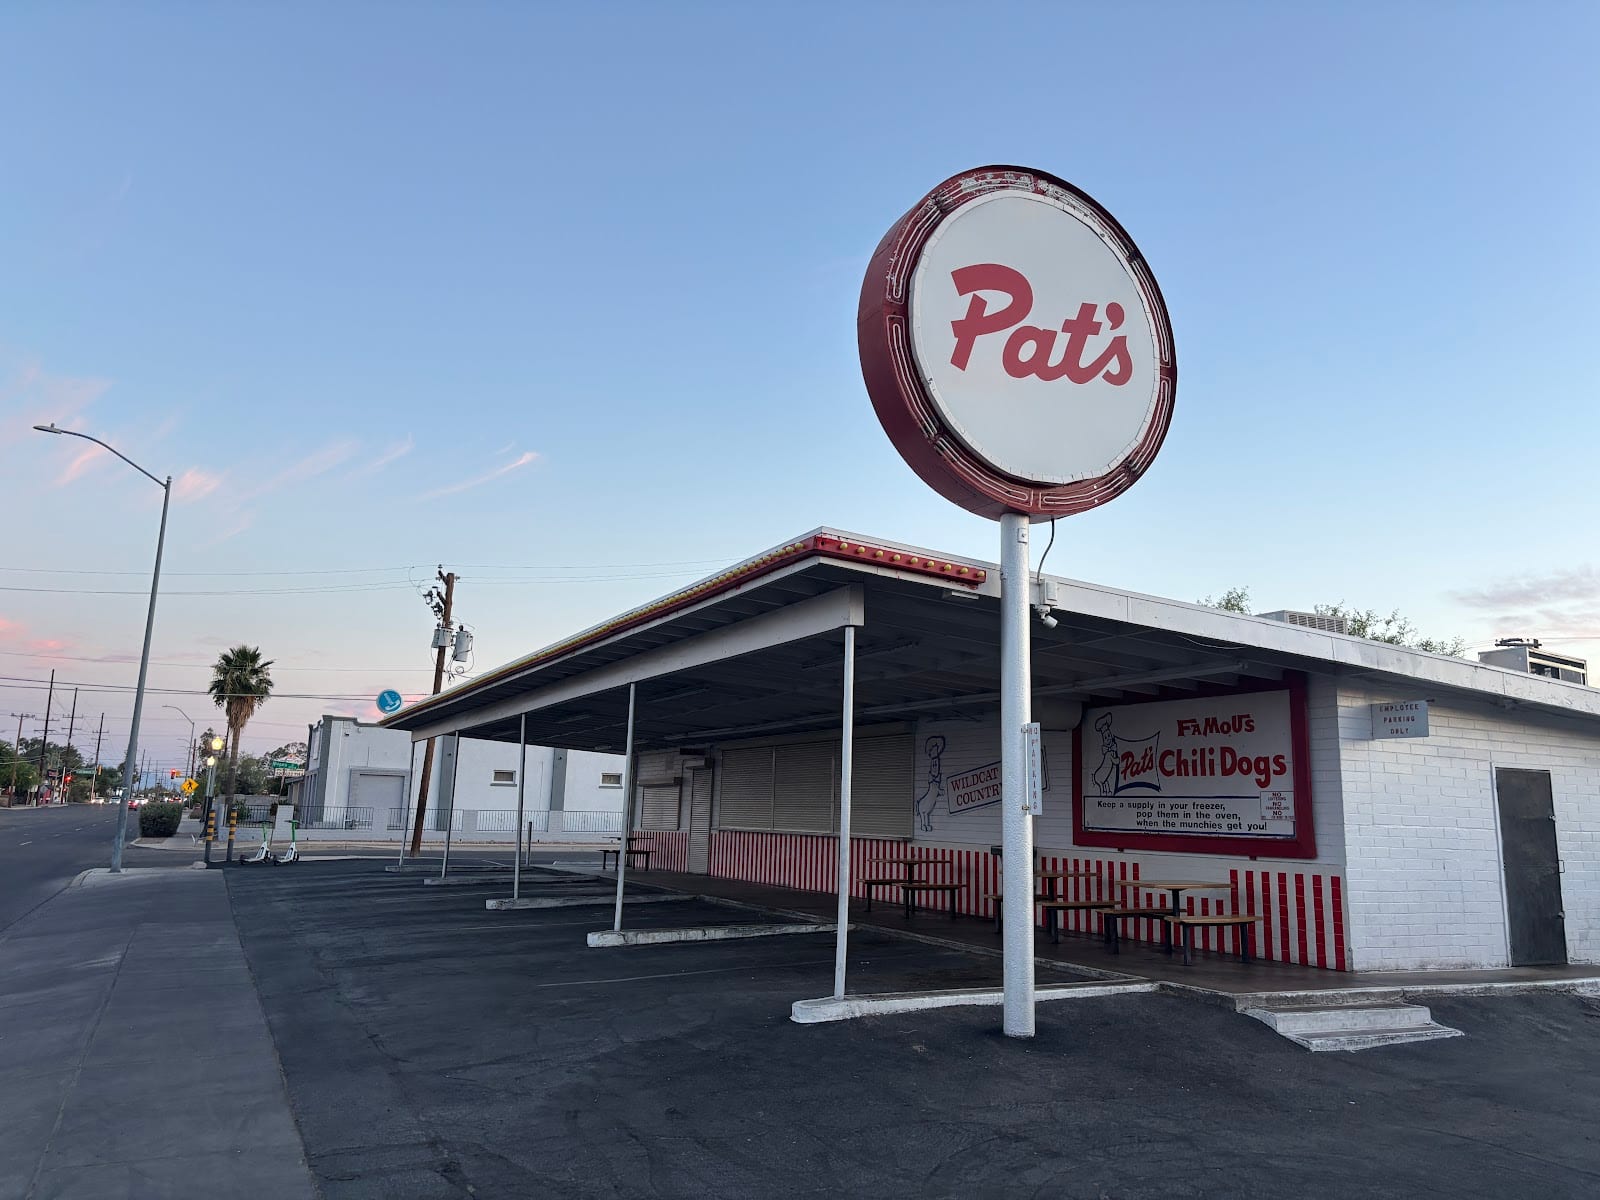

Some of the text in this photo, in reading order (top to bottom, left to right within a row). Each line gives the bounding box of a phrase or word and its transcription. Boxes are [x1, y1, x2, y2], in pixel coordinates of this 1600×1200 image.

[950, 263, 1133, 386] Pat's
[1379, 703, 1419, 712] EMPLOYEE
[1383, 715, 1415, 724] PARKING
[1390, 727, 1409, 735] ONLY
[1120, 745, 1154, 781] Pat's
[1159, 746, 1287, 788] Chili Dogs
[950, 767, 999, 792] WILDCAT
[1097, 800, 1116, 809] Keep
[1127, 801, 1154, 810] supply
[1158, 801, 1166, 809] in
[1169, 802, 1189, 811] your
[1192, 801, 1226, 811] freezer,
[1157, 810, 1179, 819] them
[1183, 810, 1191, 819] in
[1196, 811, 1211, 819] the
[1215, 812, 1241, 821] oven,
[1136, 818, 1267, 832] when the munchies get you!
